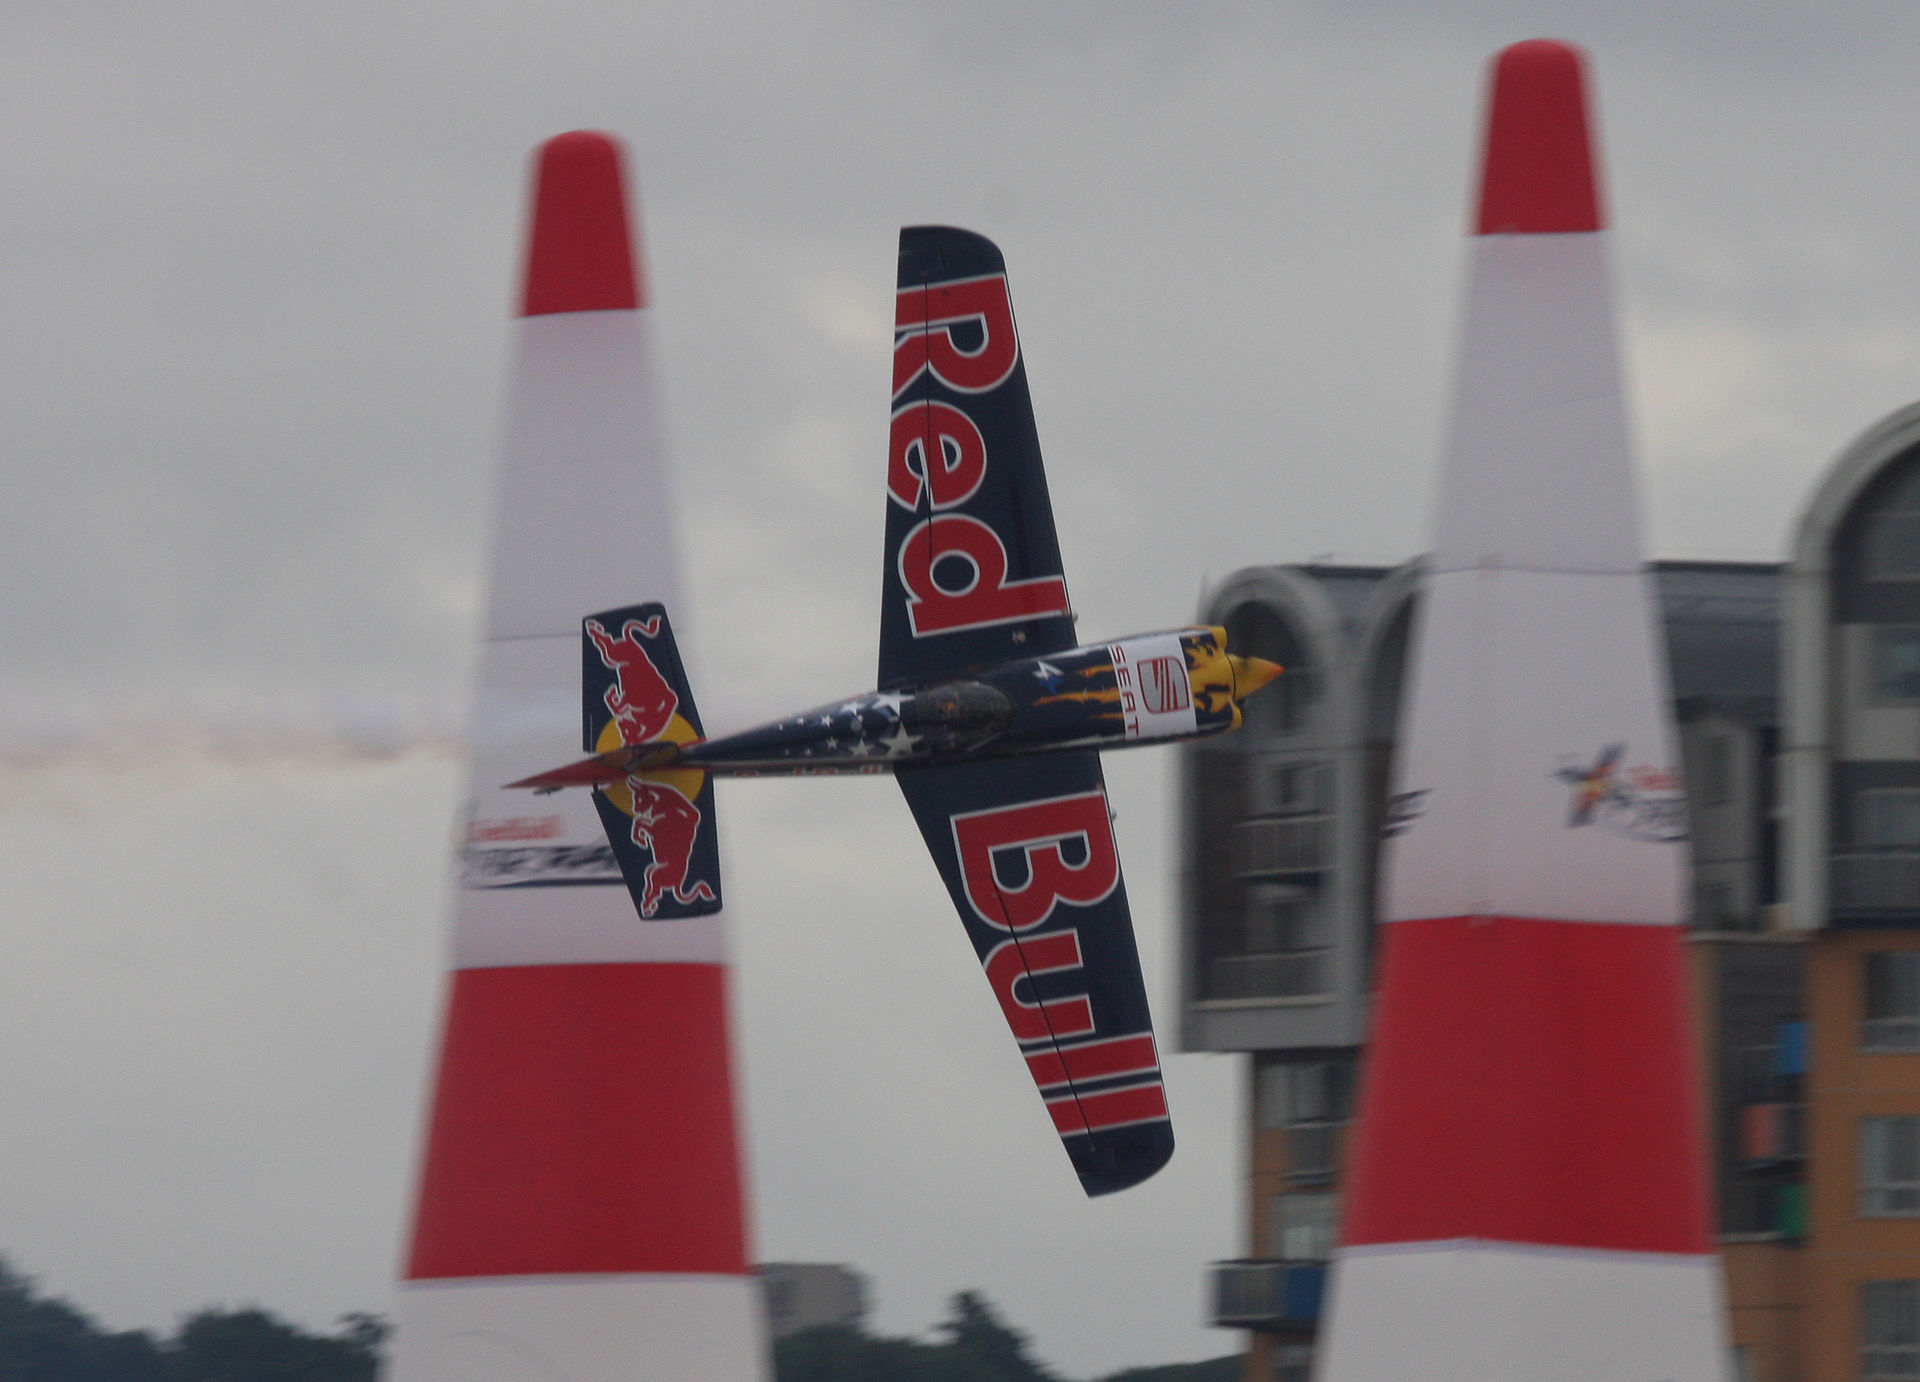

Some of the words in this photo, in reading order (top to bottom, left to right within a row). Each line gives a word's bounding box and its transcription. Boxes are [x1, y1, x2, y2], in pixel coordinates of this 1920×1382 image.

[886, 272, 1069, 638] Red
[1111, 645, 1139, 736] SEAT
[950, 789, 1169, 1137] Bull
